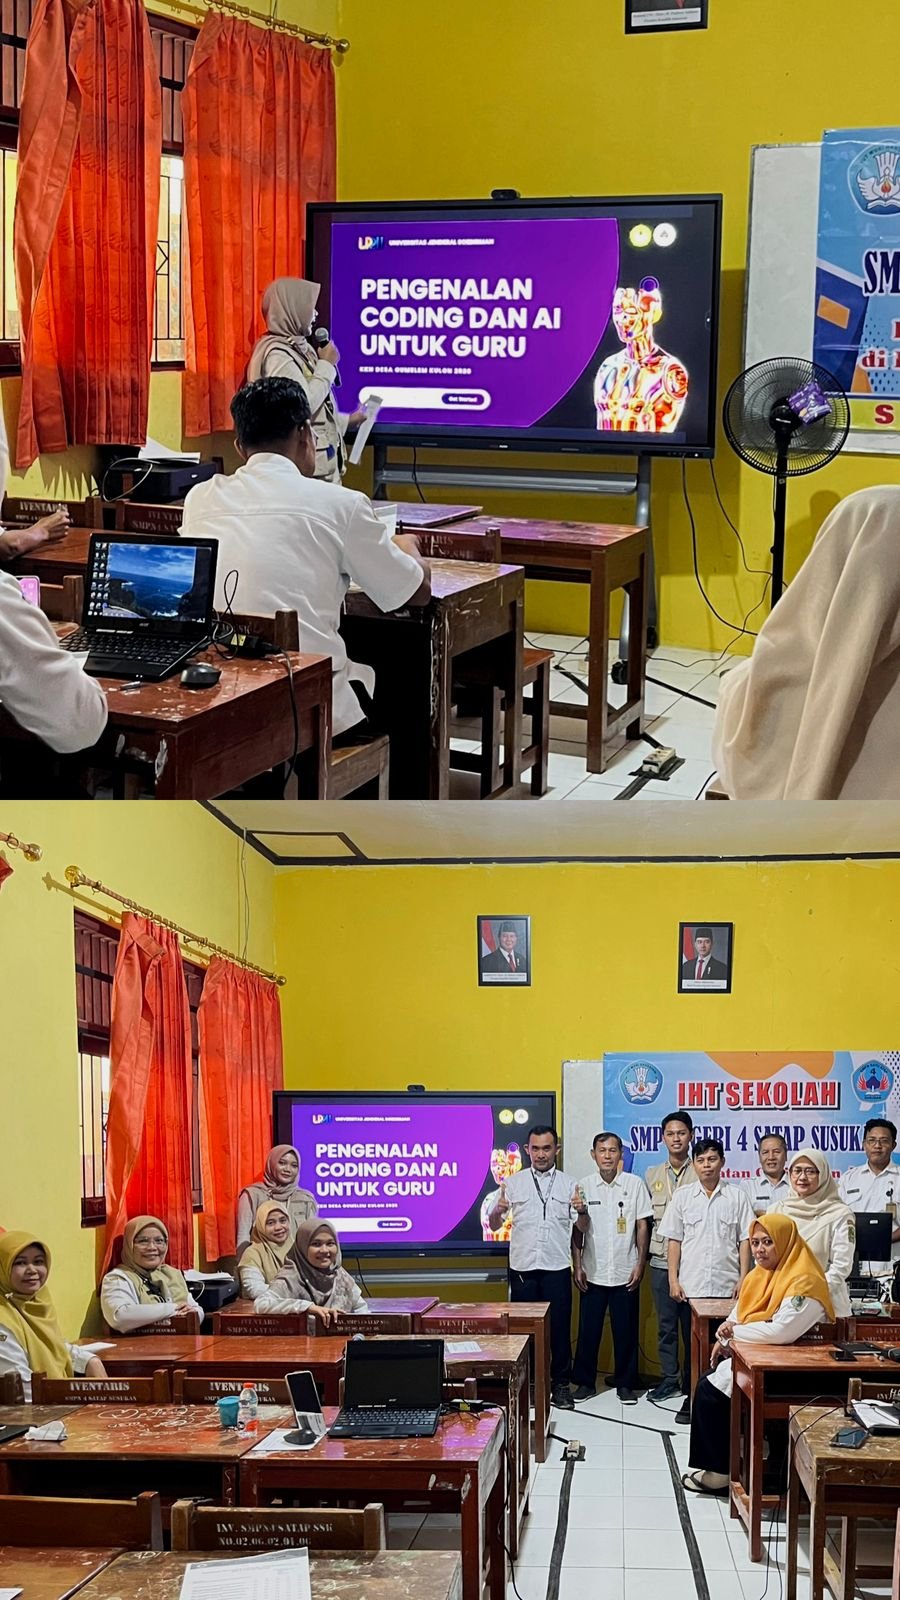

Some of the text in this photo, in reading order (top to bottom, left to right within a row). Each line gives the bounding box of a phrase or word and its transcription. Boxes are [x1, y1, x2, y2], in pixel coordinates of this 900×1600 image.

[361, 278, 533, 301] PENGENALAN
[360, 306, 561, 330] CODING DAN AI
[360, 334, 526, 358] UNTUK GURU
[861, 350, 886, 368] di
[677, 1081, 839, 1110] IHT SEKOLAH
[630, 1125, 865, 1152] SMP GERI 4 SAP SUSUK
[315, 1143, 438, 1158] PENGENALAN
[315, 1162, 458, 1178] CODING DAN AI
[316, 1181, 435, 1197] UNTUK GURU
[69, 1381, 130, 1391] IVENTARIS
[209, 1381, 270, 1392] IVENTRIS
